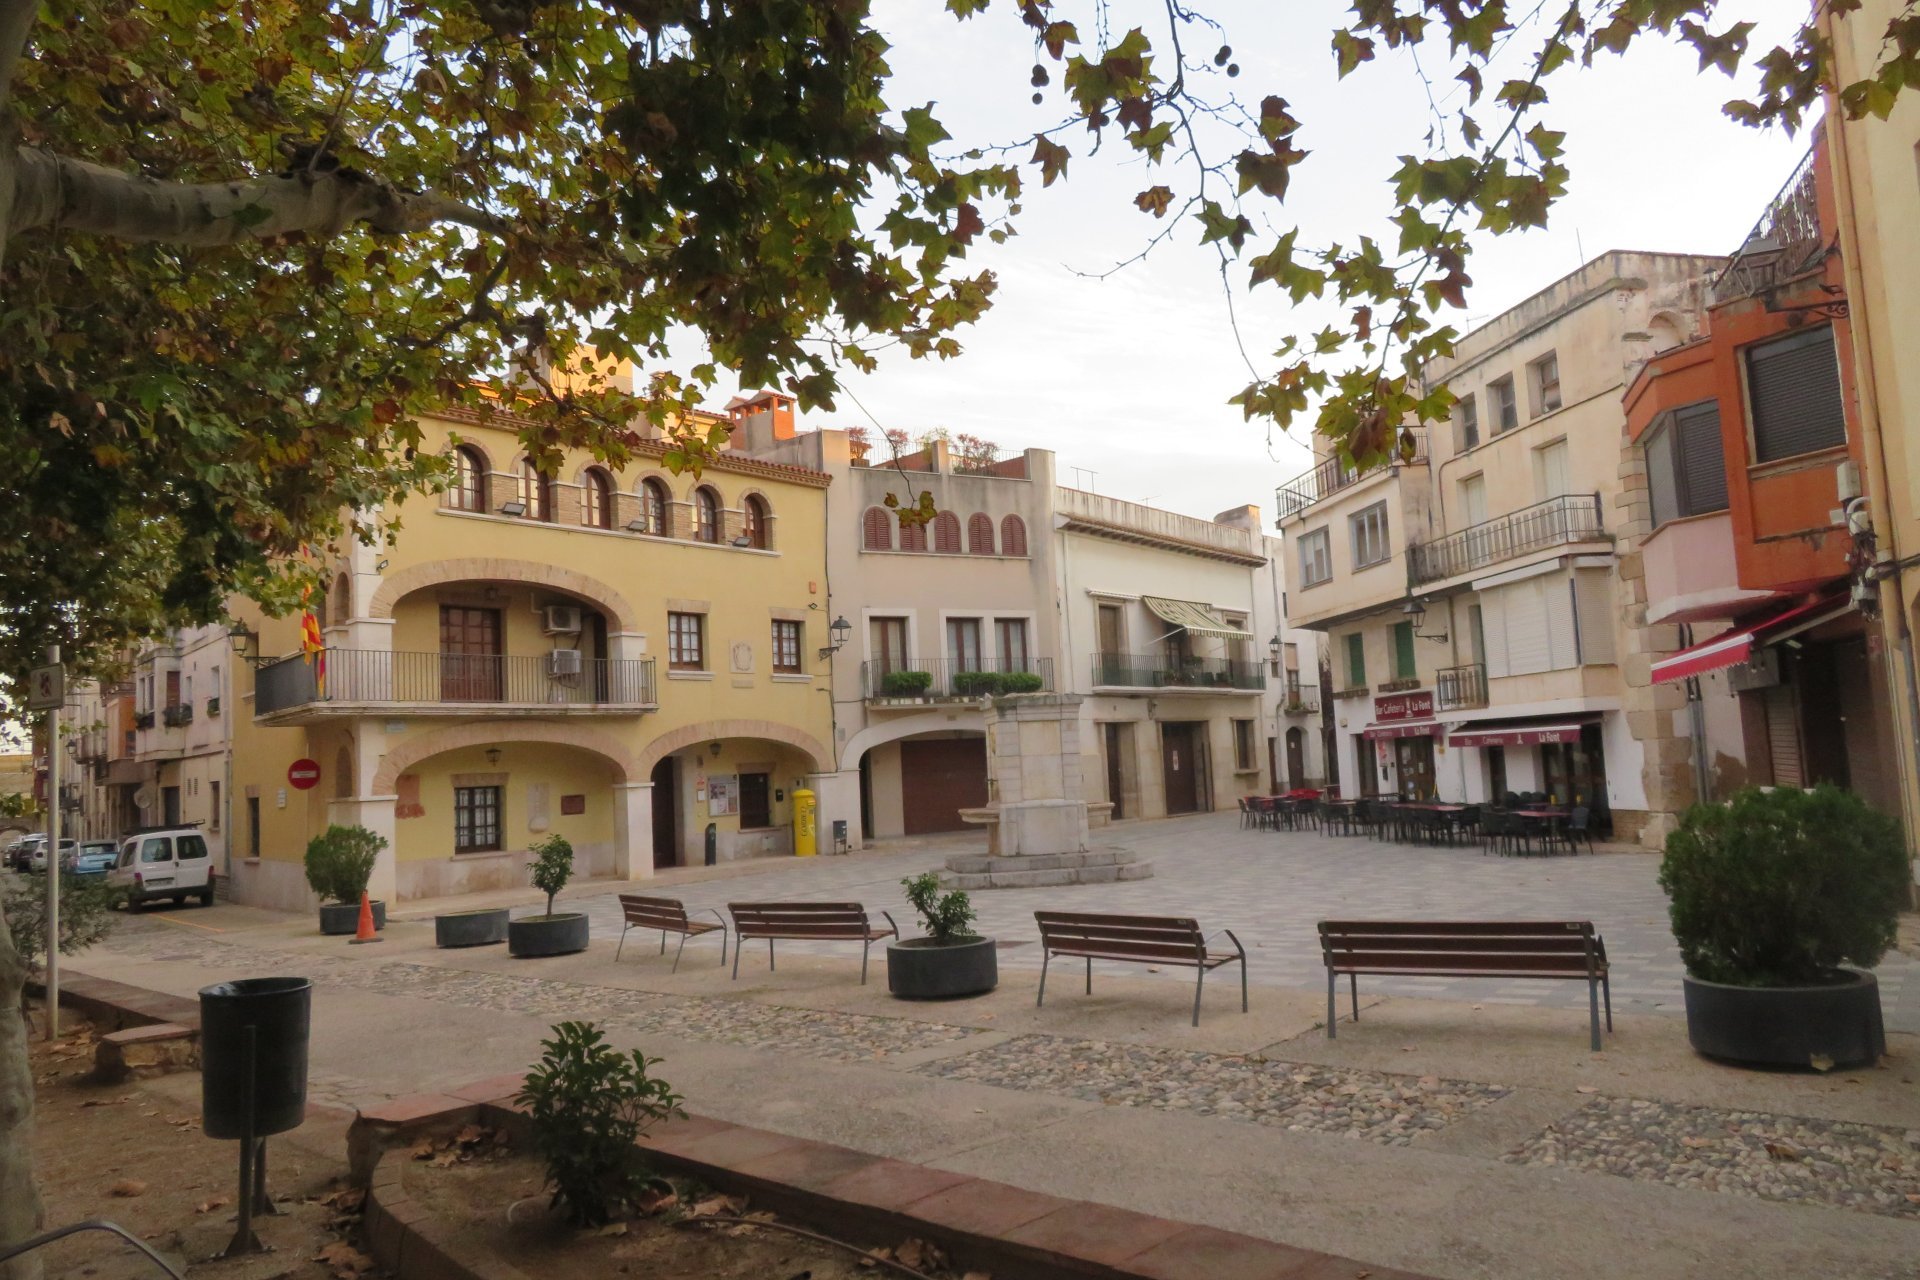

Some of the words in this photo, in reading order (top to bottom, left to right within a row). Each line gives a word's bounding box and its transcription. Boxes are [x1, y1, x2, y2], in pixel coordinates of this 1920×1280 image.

[1412, 702, 1418, 711] La
[1419, 700, 1430, 710] Font
[1538, 733, 1546, 742] La
[1546, 732, 1560, 742] Font
